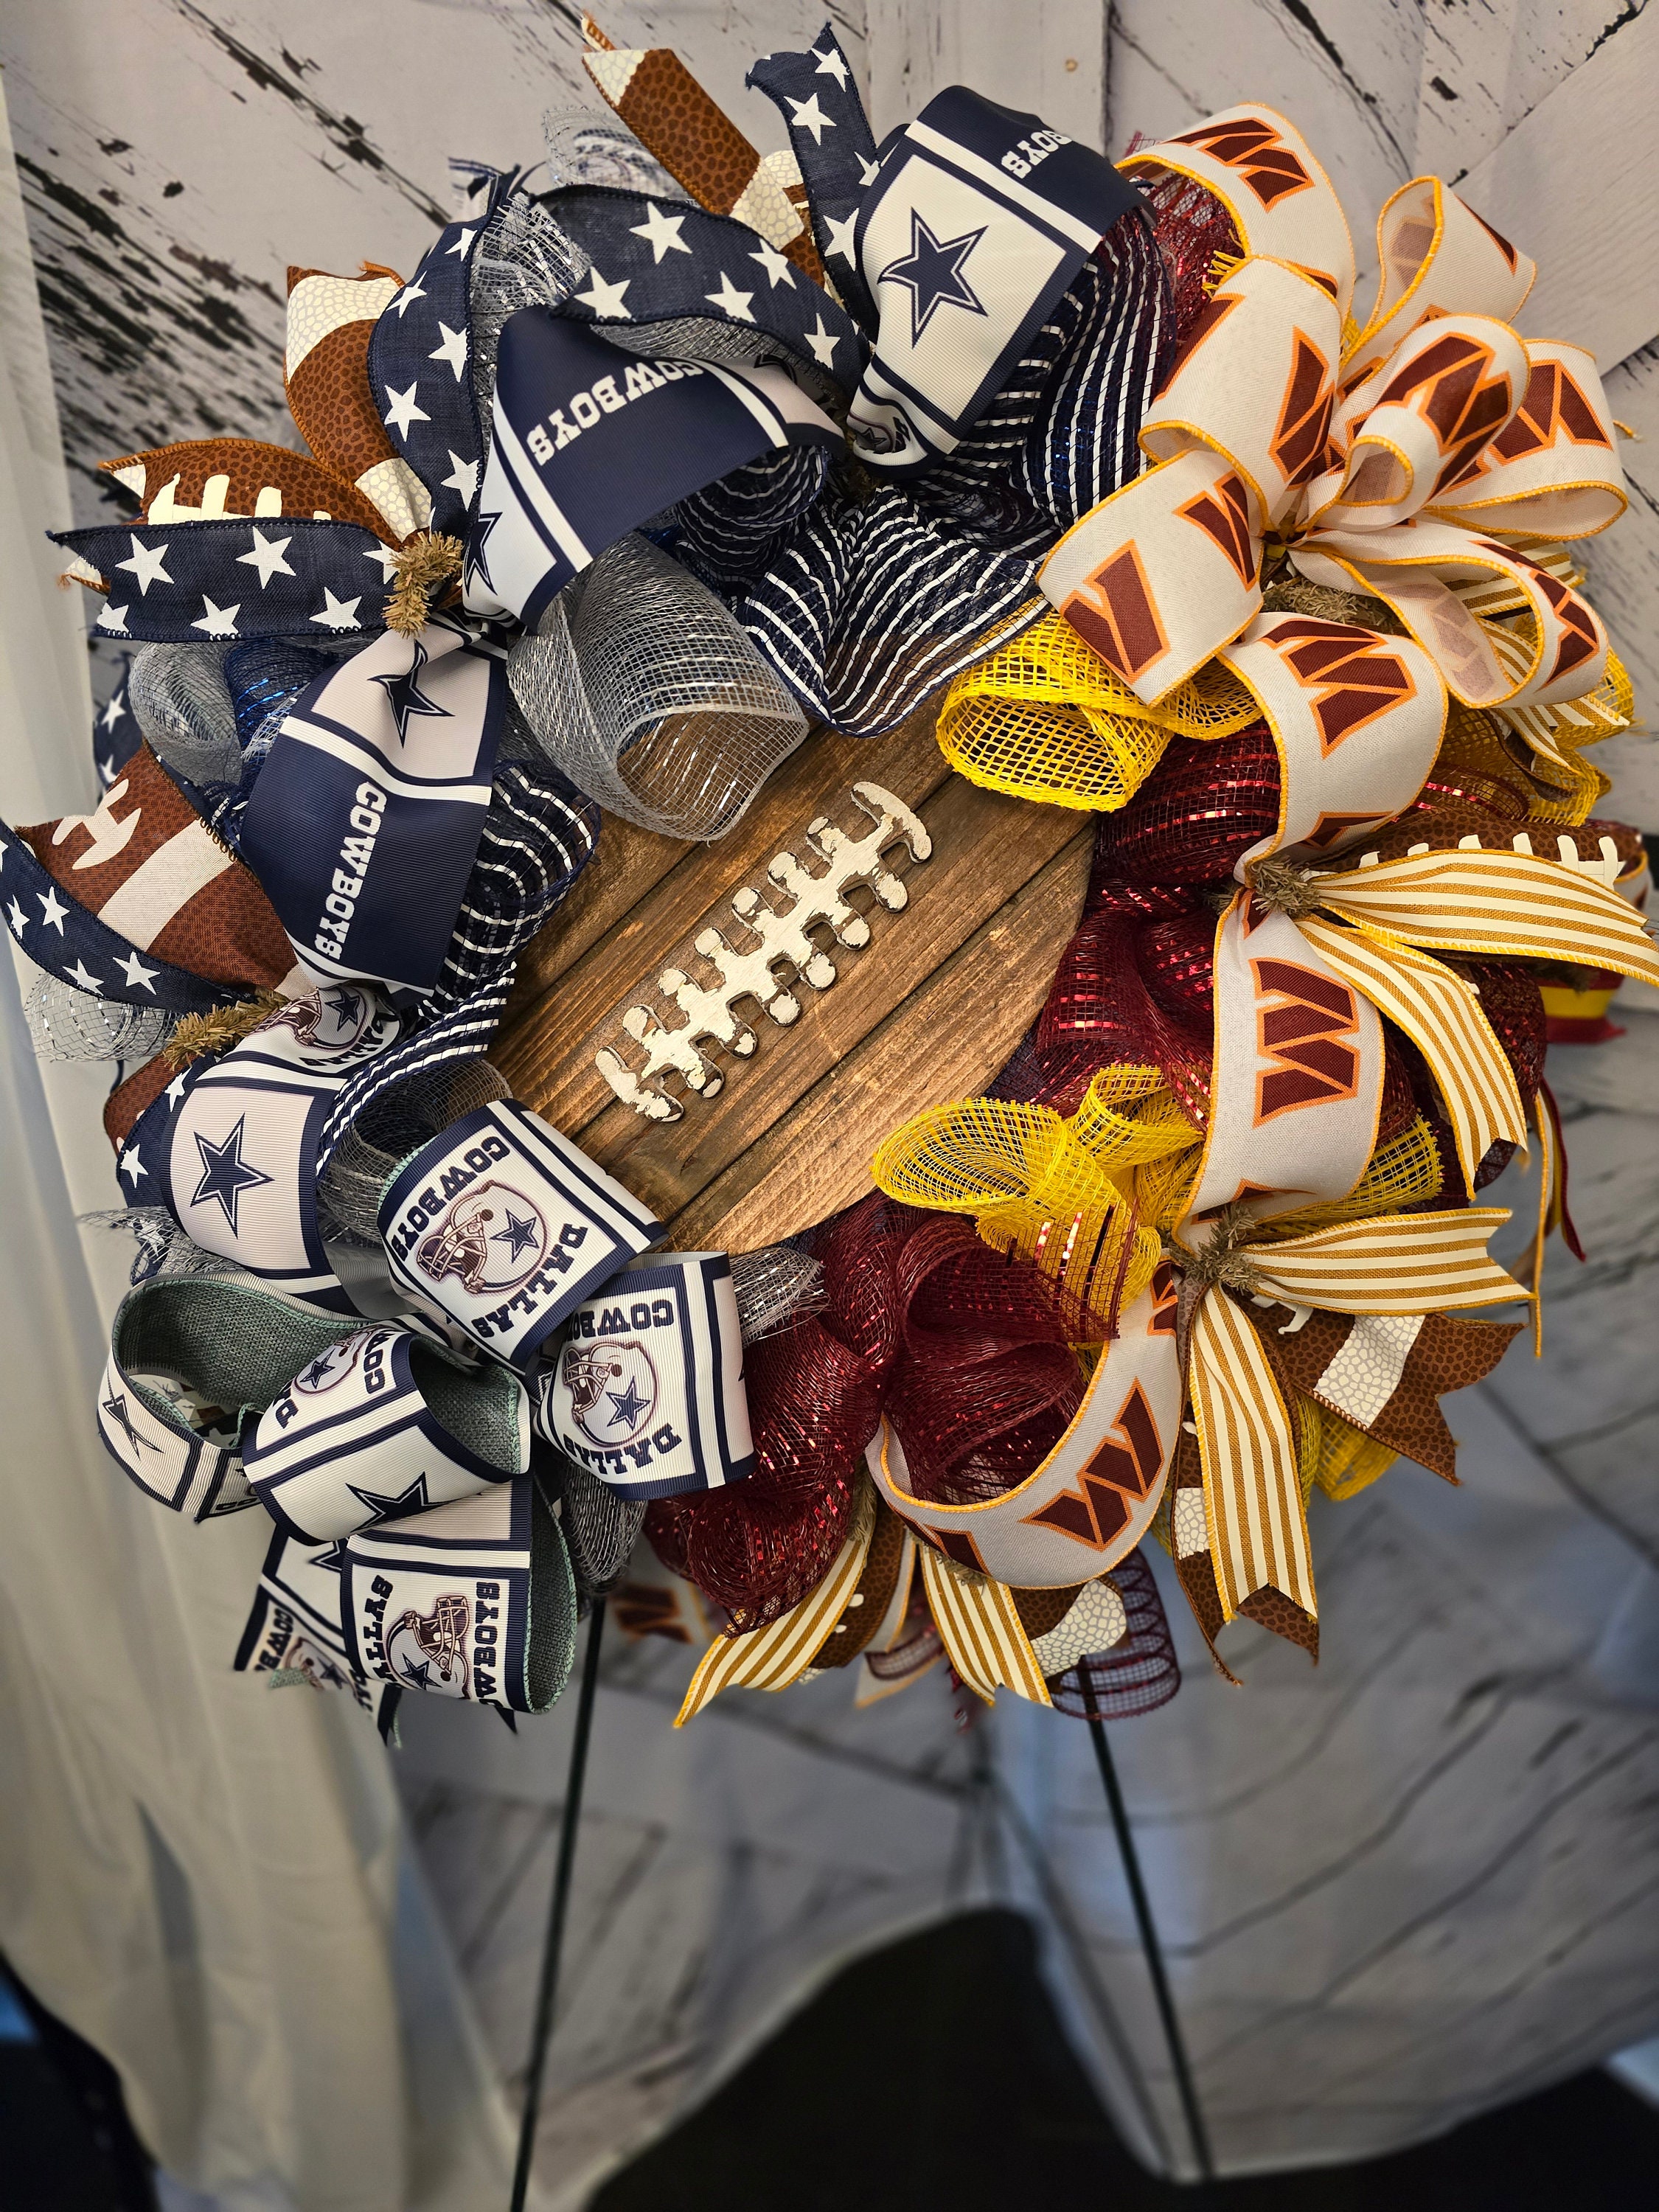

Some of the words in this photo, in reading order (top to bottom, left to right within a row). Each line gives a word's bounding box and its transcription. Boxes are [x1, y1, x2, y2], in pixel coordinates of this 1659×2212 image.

[1001, 130, 1073, 179] BOYS
[526, 361, 704, 466] COWBOYS
[314, 782, 387, 960] COWBOYS
[391, 1135, 510, 1262] COWBOYS
[470, 1222, 588, 1338] DALLAS
[563, 1422, 683, 1475] DALLAS
[254, 1607, 293, 1671] COWB
[364, 1575, 399, 1683] ALLAS
